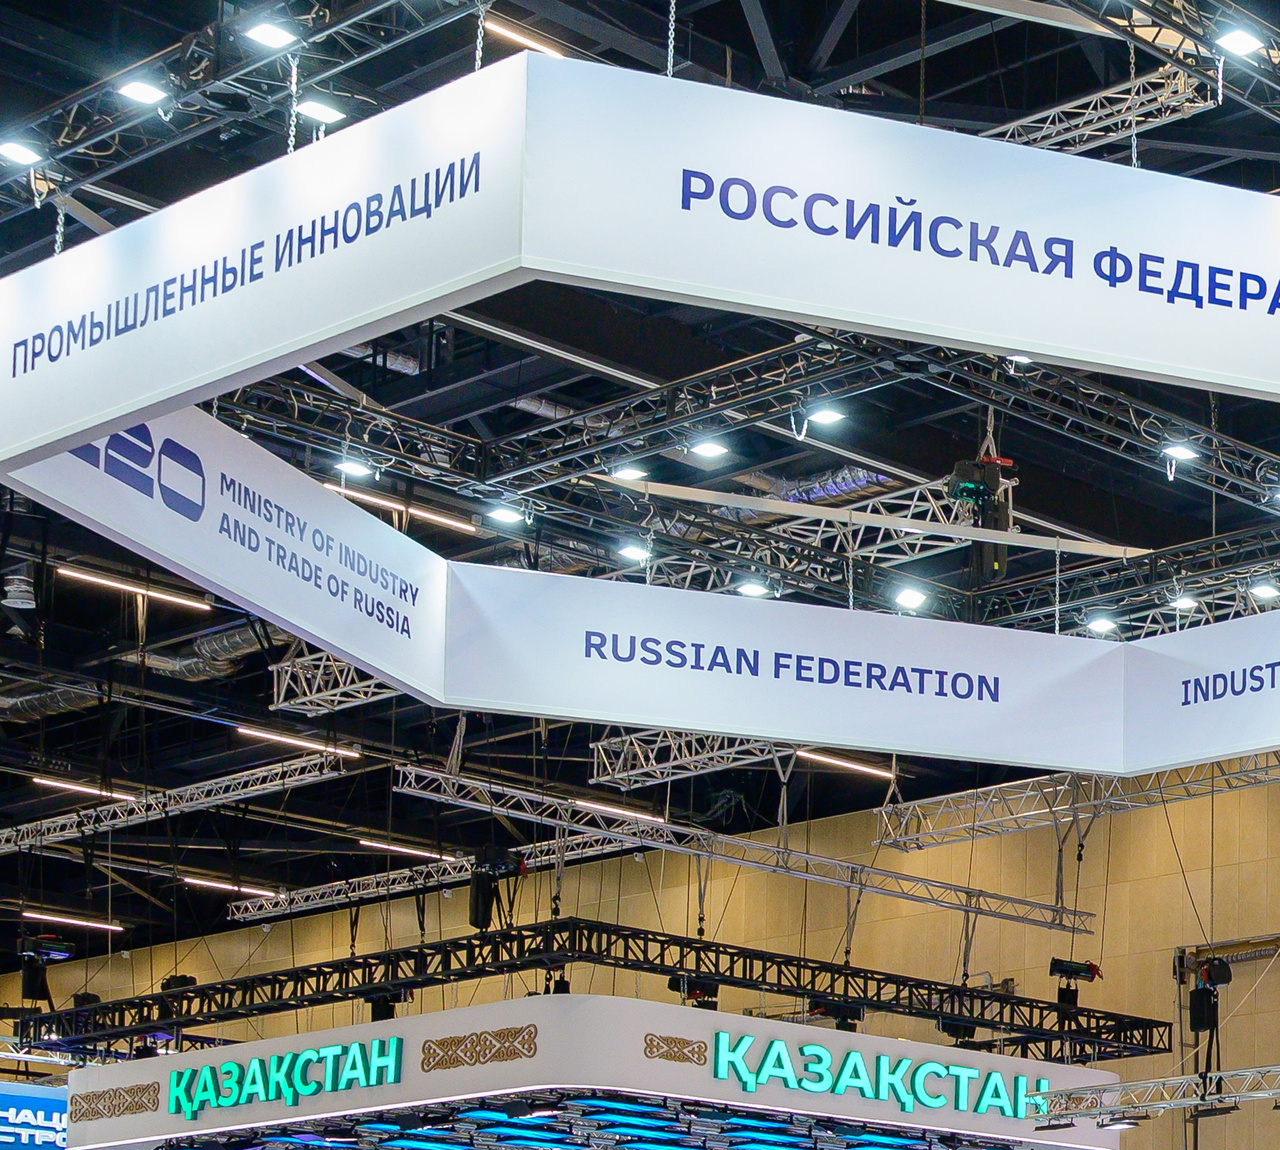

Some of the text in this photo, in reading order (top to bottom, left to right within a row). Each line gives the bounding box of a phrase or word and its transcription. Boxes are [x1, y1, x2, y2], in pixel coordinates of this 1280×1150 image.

[11, 151, 481, 379] ПРОМЫШЛЕННЫЕ ИННОВАЦИИ
[681, 167, 1074, 279] РОССИЙСКАЯ
[218, 512, 411, 640] AND TRADE OF RUSSIA
[220, 471, 419, 607] MINISTRY OF INDUSTRY
[584, 629, 1000, 703] RUSSIAN FEDERATION
[167, 1036, 404, 1121] ҚАЗАҚСТАН
